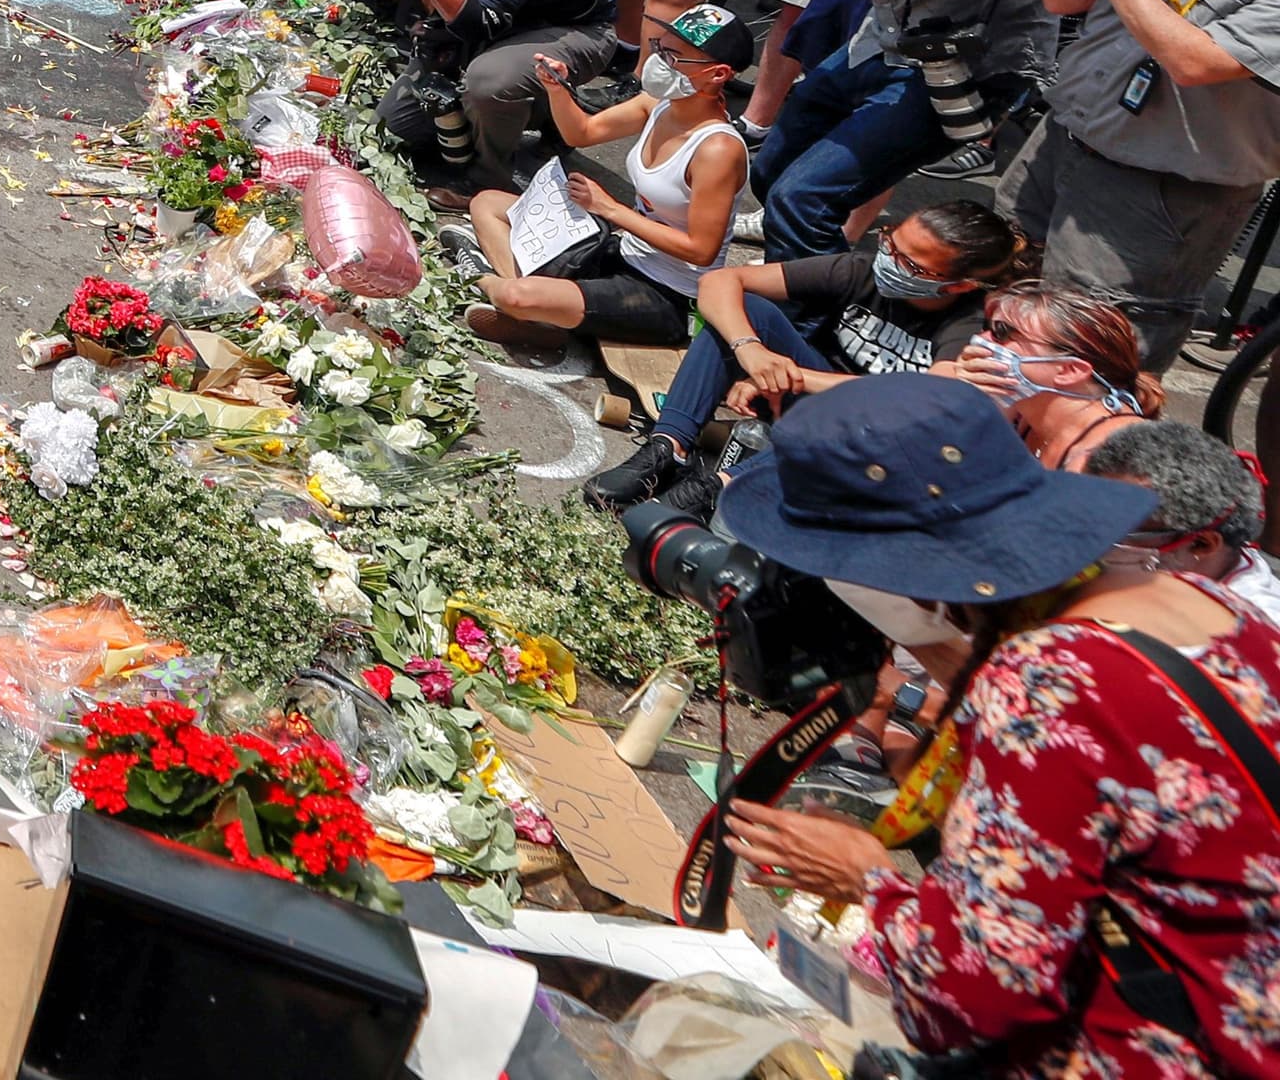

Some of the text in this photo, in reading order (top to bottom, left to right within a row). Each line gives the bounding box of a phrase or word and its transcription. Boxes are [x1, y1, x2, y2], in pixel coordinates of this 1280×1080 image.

[717, 438, 740, 474] sentia
[777, 706, 841, 762] Canon
[680, 838, 716, 918] Canon
